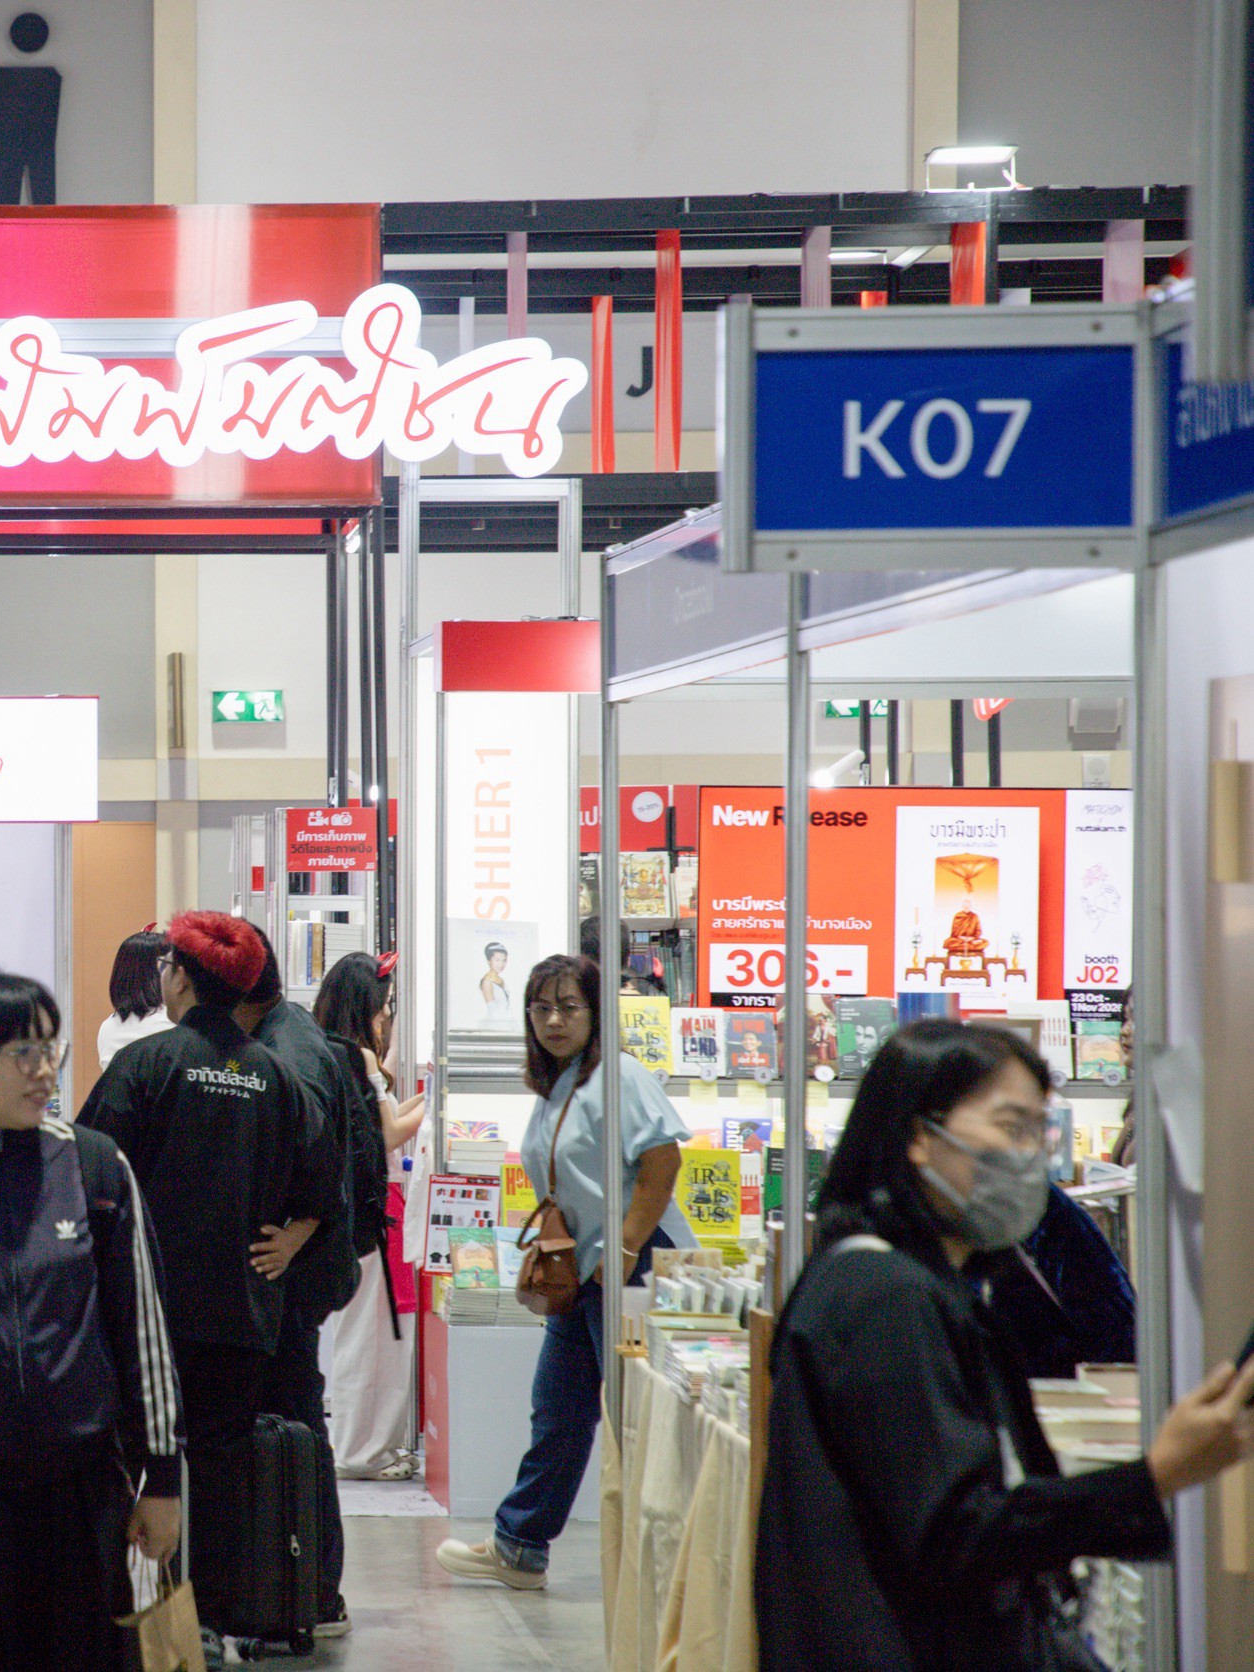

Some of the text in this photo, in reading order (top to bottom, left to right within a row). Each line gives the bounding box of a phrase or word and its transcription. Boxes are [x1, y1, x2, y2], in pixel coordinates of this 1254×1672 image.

[626, 345, 653, 397] J
[843, 398, 1032, 479] K07
[474, 748, 511, 764] 1
[712, 805, 868, 827] New Rease
[474, 780, 511, 920] SHIER
[1084, 954, 1119, 964] booth
[1076, 965, 1120, 984] J02
[732, 994, 776, 1007] จากรา
[431, 1175, 468, 1185] Promotion
